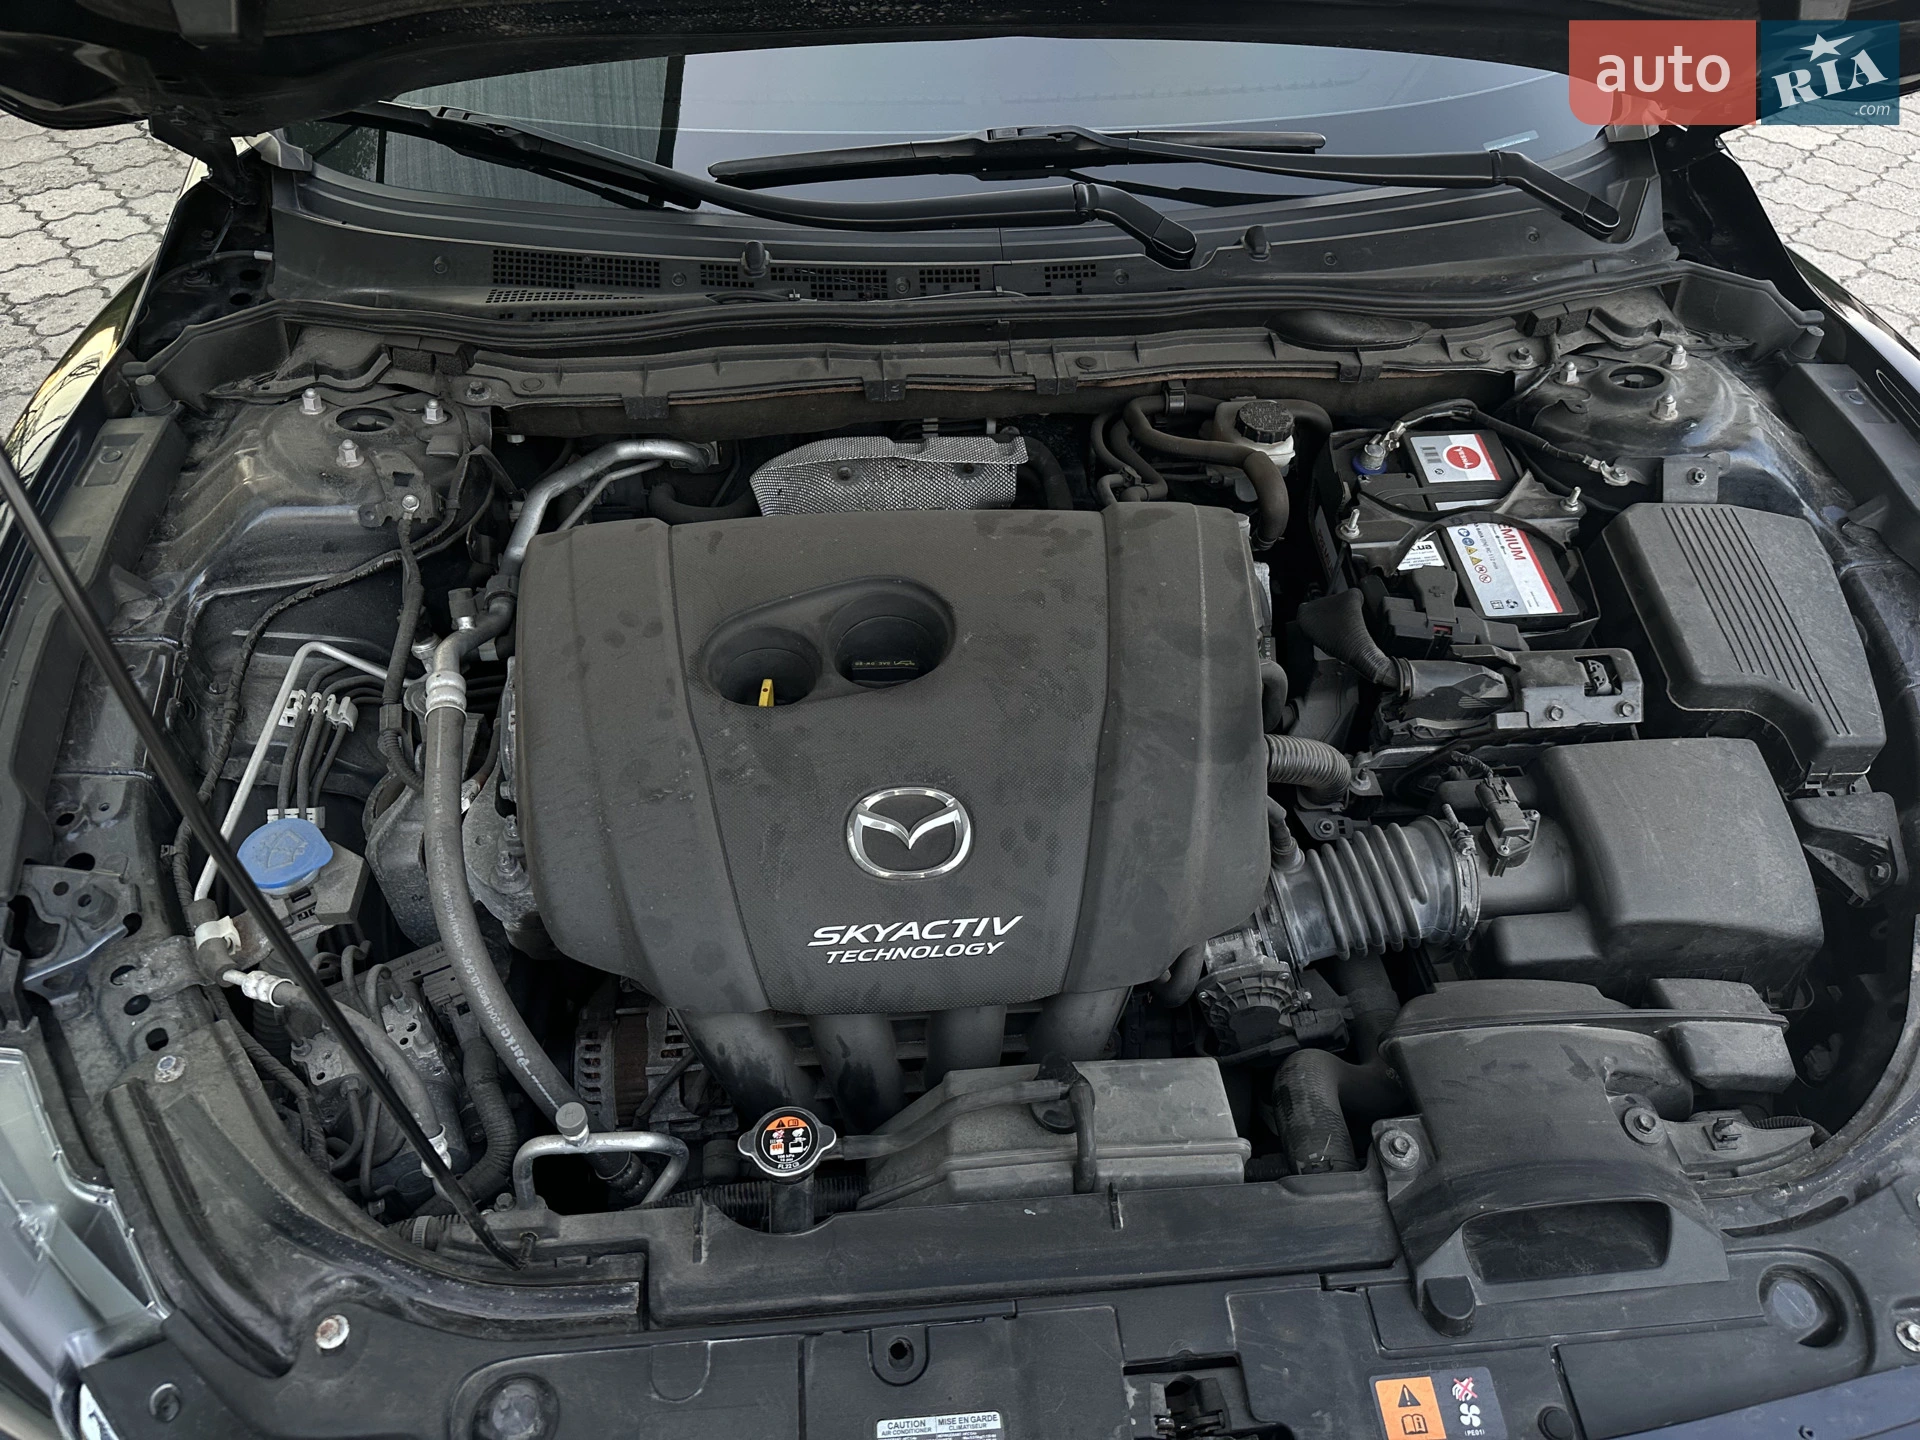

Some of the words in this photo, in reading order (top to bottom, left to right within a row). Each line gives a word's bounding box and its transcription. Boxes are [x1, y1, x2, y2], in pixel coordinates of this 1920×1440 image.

[808, 916, 1023, 946] SKYACTIV
[826, 942, 1005, 964] TECHNOLOGY
[496, 1022, 530, 1067] Parker
[888, 1420, 926, 1430] CAUTION
[938, 1418, 958, 1426] MISE
[958, 1416, 969, 1424] EN
[970, 1414, 998, 1422] GARDE
[892, 1428, 932, 1436] CONDITIONER
[948, 1423, 987, 1431] CLIMATISEUR
